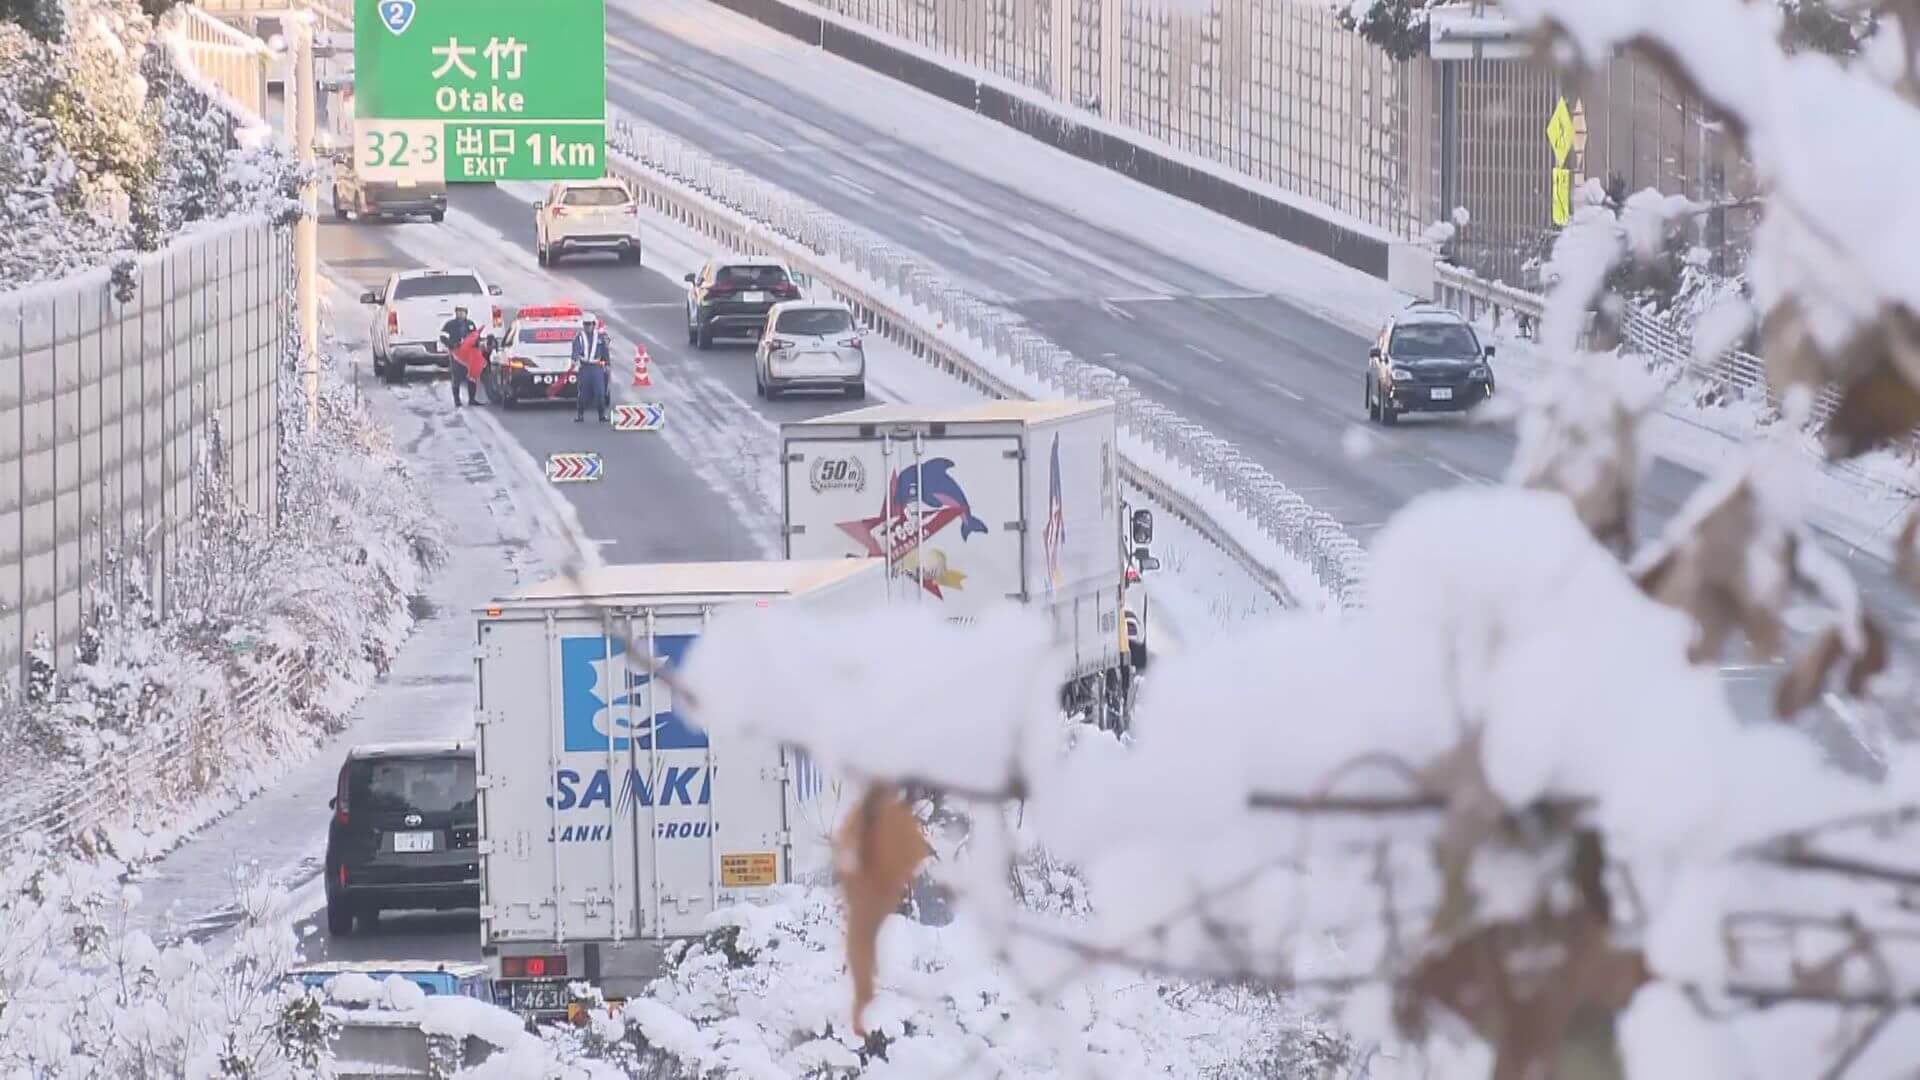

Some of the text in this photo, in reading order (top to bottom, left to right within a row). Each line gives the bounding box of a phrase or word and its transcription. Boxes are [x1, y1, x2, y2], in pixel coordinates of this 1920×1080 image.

[389, 3, 405, 25] 2
[432, 37, 528, 80] 大竹
[435, 85, 525, 113] Otake
[364, 131, 438, 167] 32-3
[455, 127, 516, 156] 出口
[463, 157, 508, 176] EXIT
[546, 765, 718, 811] SANKI
